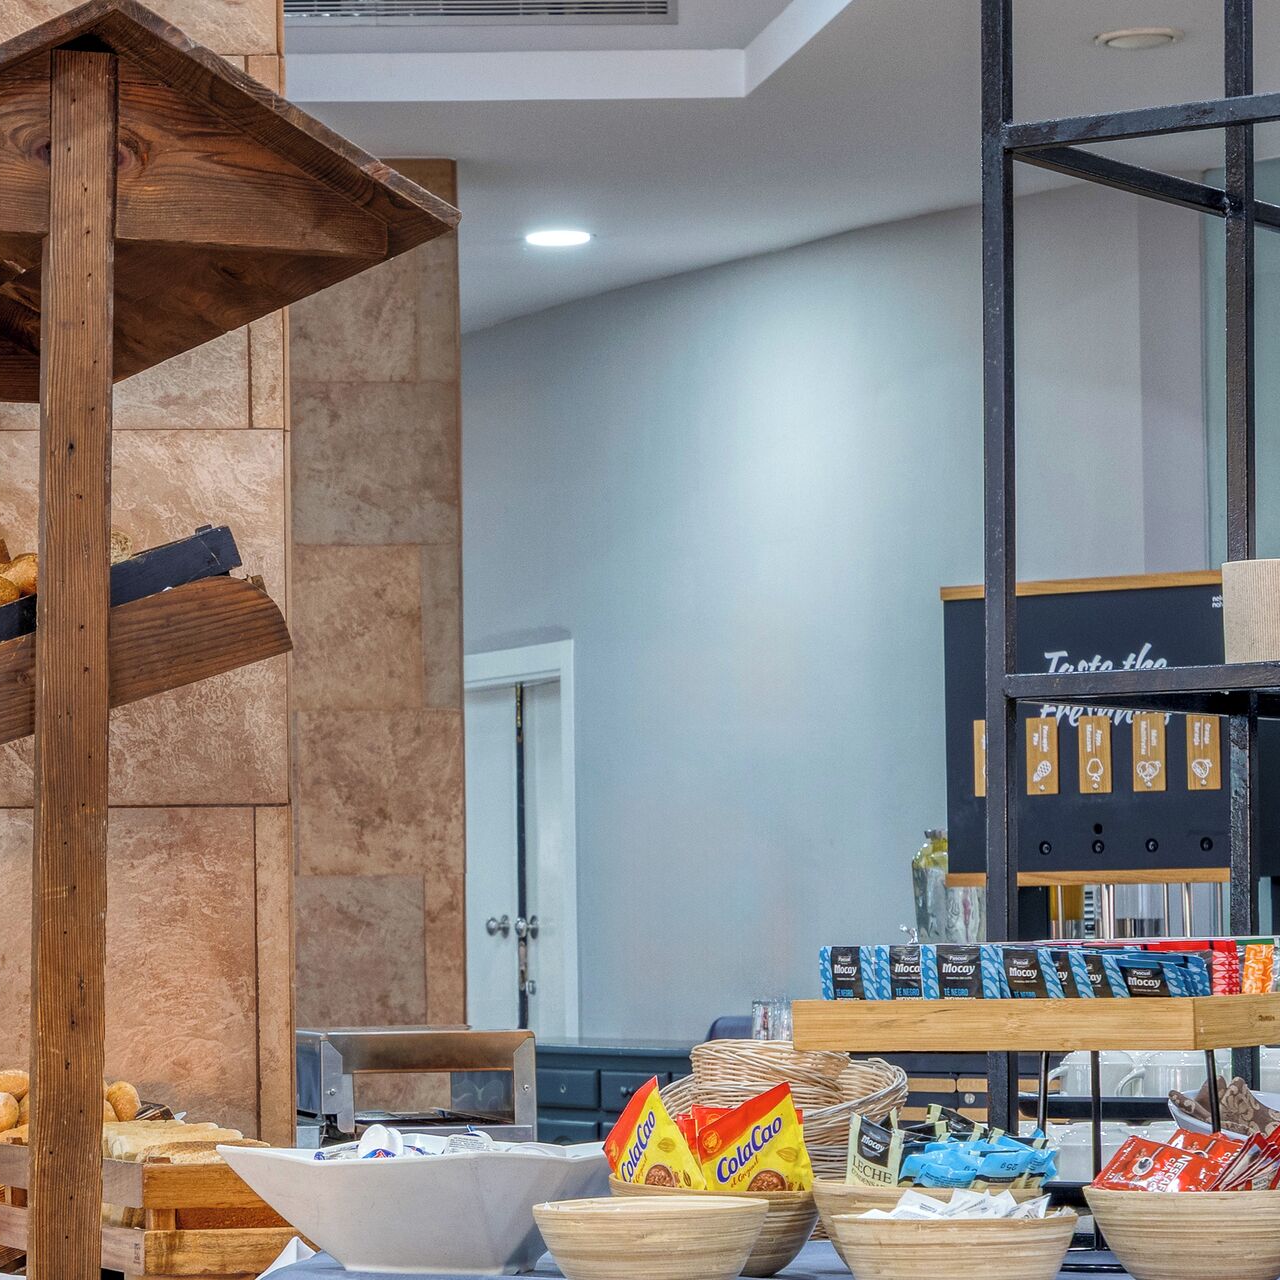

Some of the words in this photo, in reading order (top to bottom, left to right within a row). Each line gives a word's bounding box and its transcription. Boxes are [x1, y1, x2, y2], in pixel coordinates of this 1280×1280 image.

[834, 963, 857, 976] Mocay
[894, 963, 920, 973] Moca
[942, 963, 975, 976] Mocay
[1009, 967, 1037, 979] Mocay
[1128, 976, 1160, 989] Mocay
[621, 1110, 656, 1183] ColaCao
[717, 1117, 782, 1183] ColaCao
[852, 1155, 892, 1184] LECHE
[1157, 1154, 1193, 1192] NESCAF
